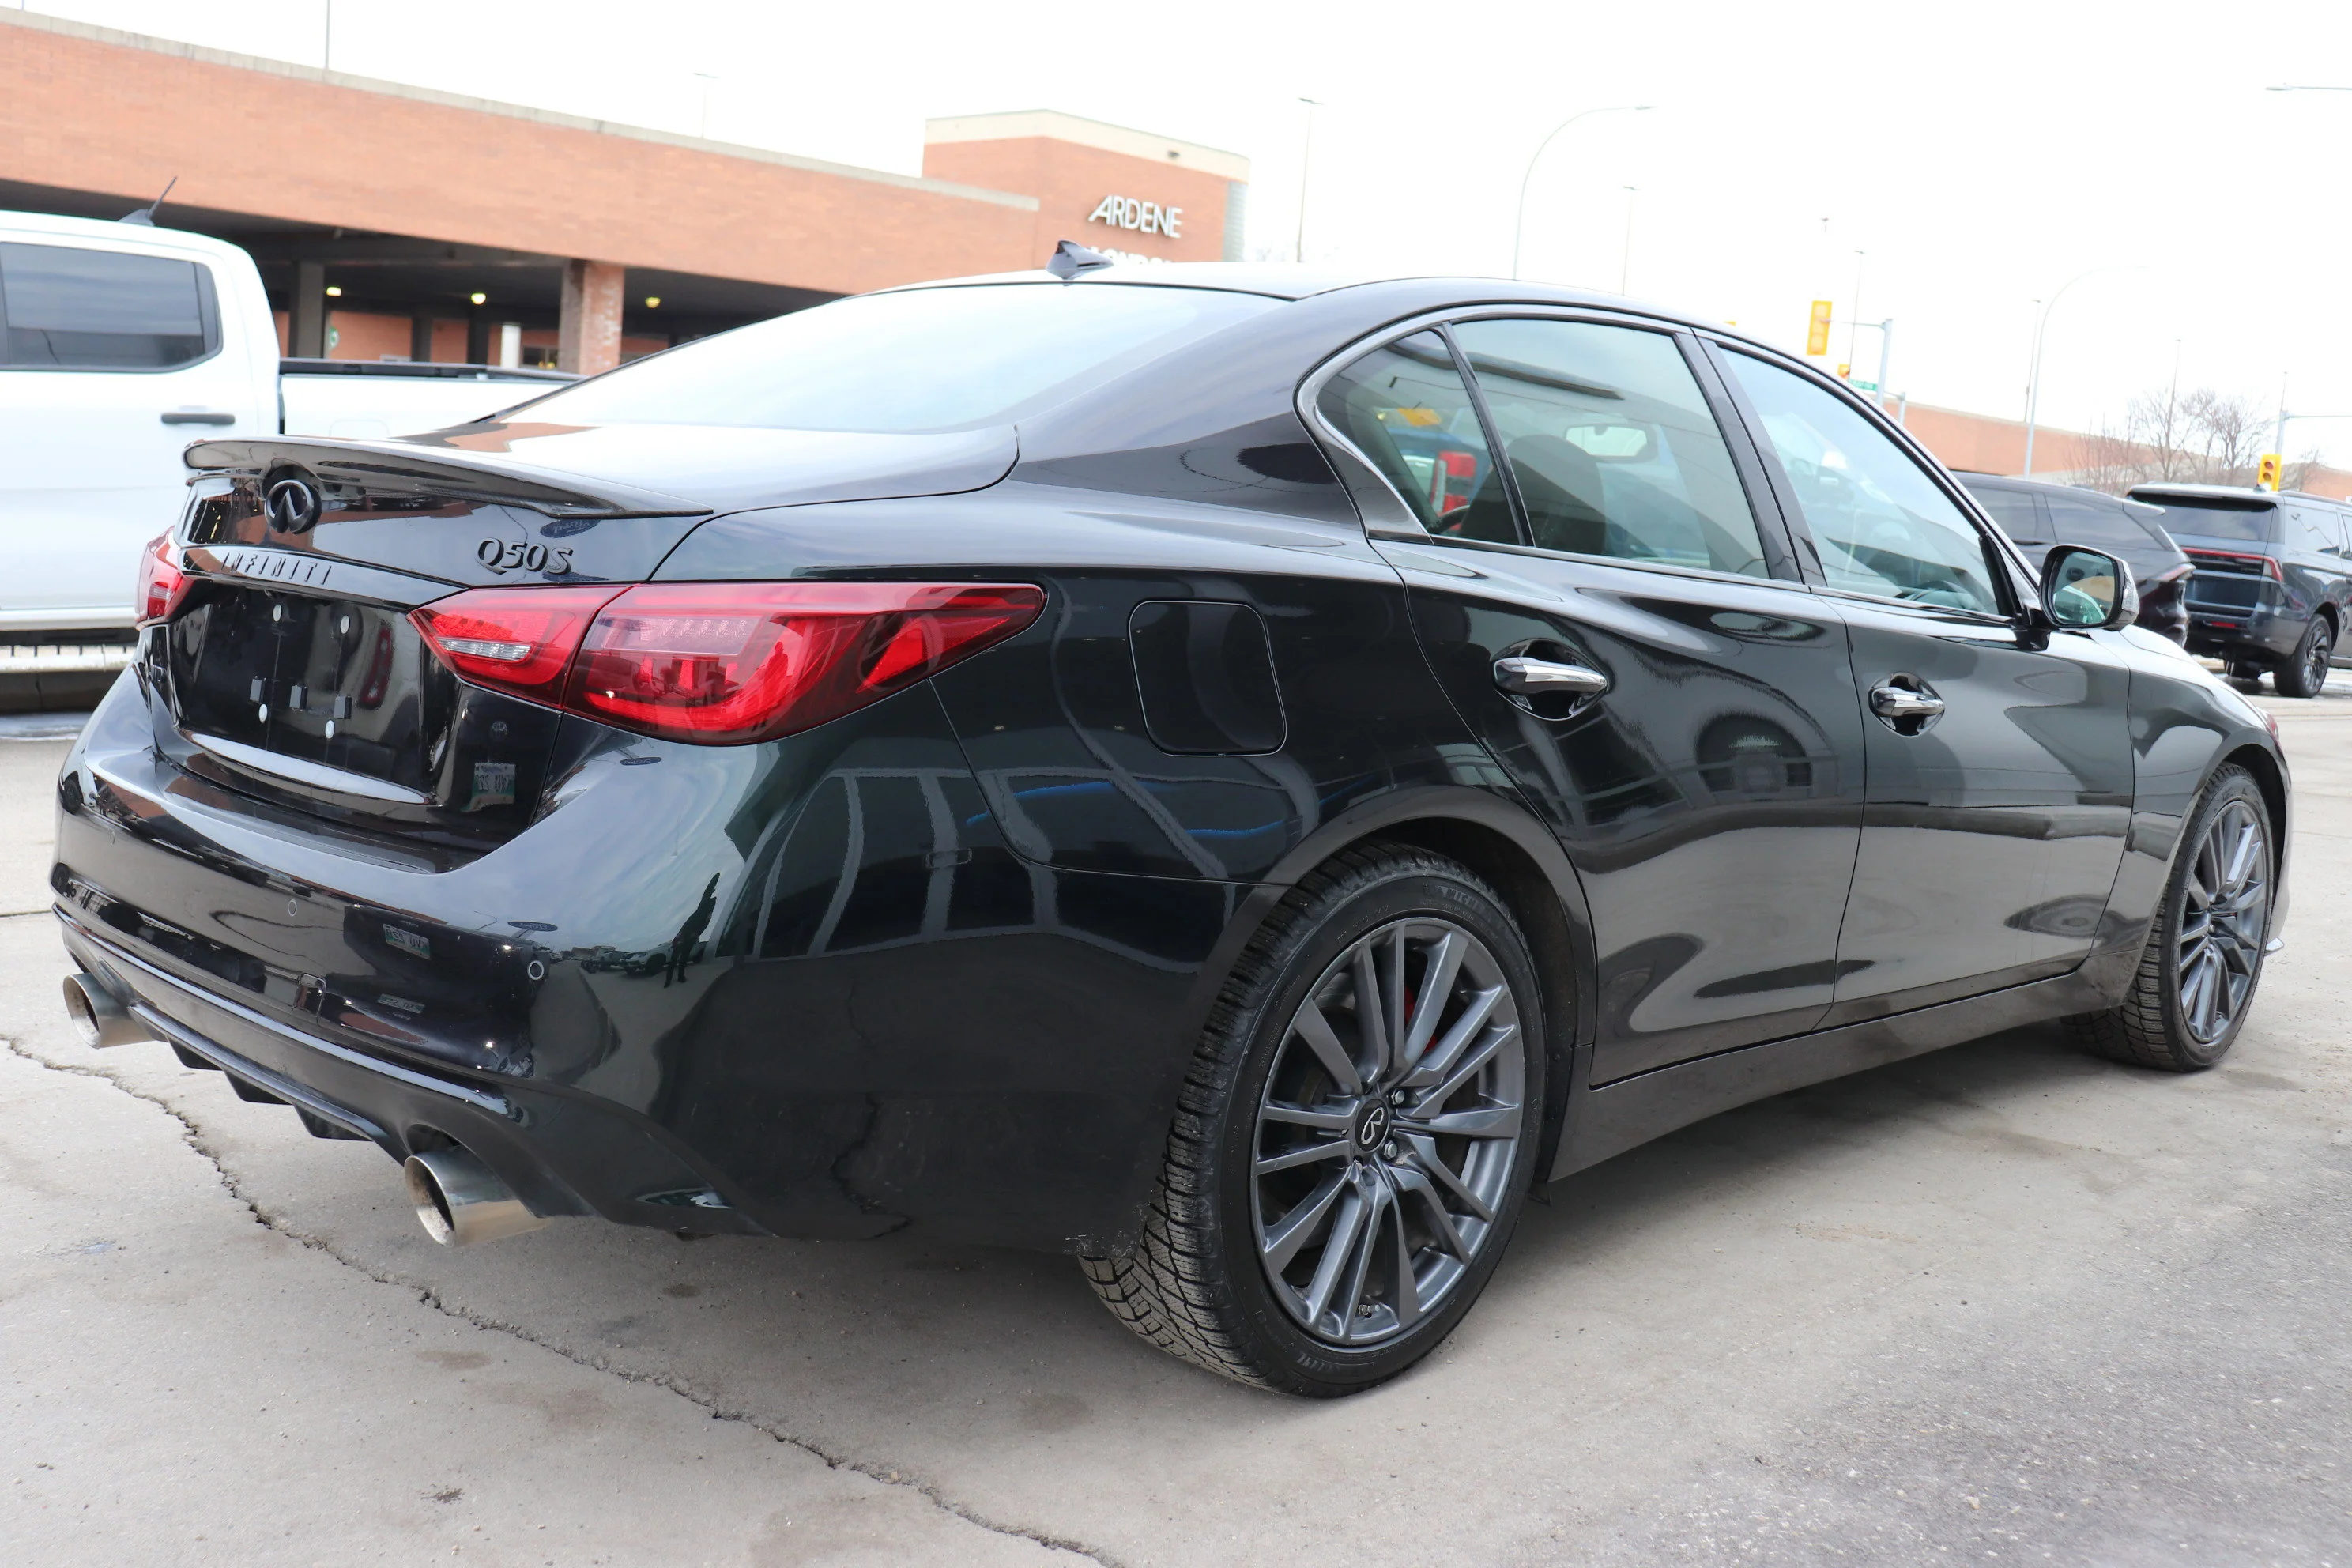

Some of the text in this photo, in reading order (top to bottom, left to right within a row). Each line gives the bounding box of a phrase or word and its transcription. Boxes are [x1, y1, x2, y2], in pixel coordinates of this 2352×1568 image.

[1087, 194, 1183, 239] ARDENE
[220, 552, 332, 586] INFINITI
[475, 537, 574, 575] Q50S
